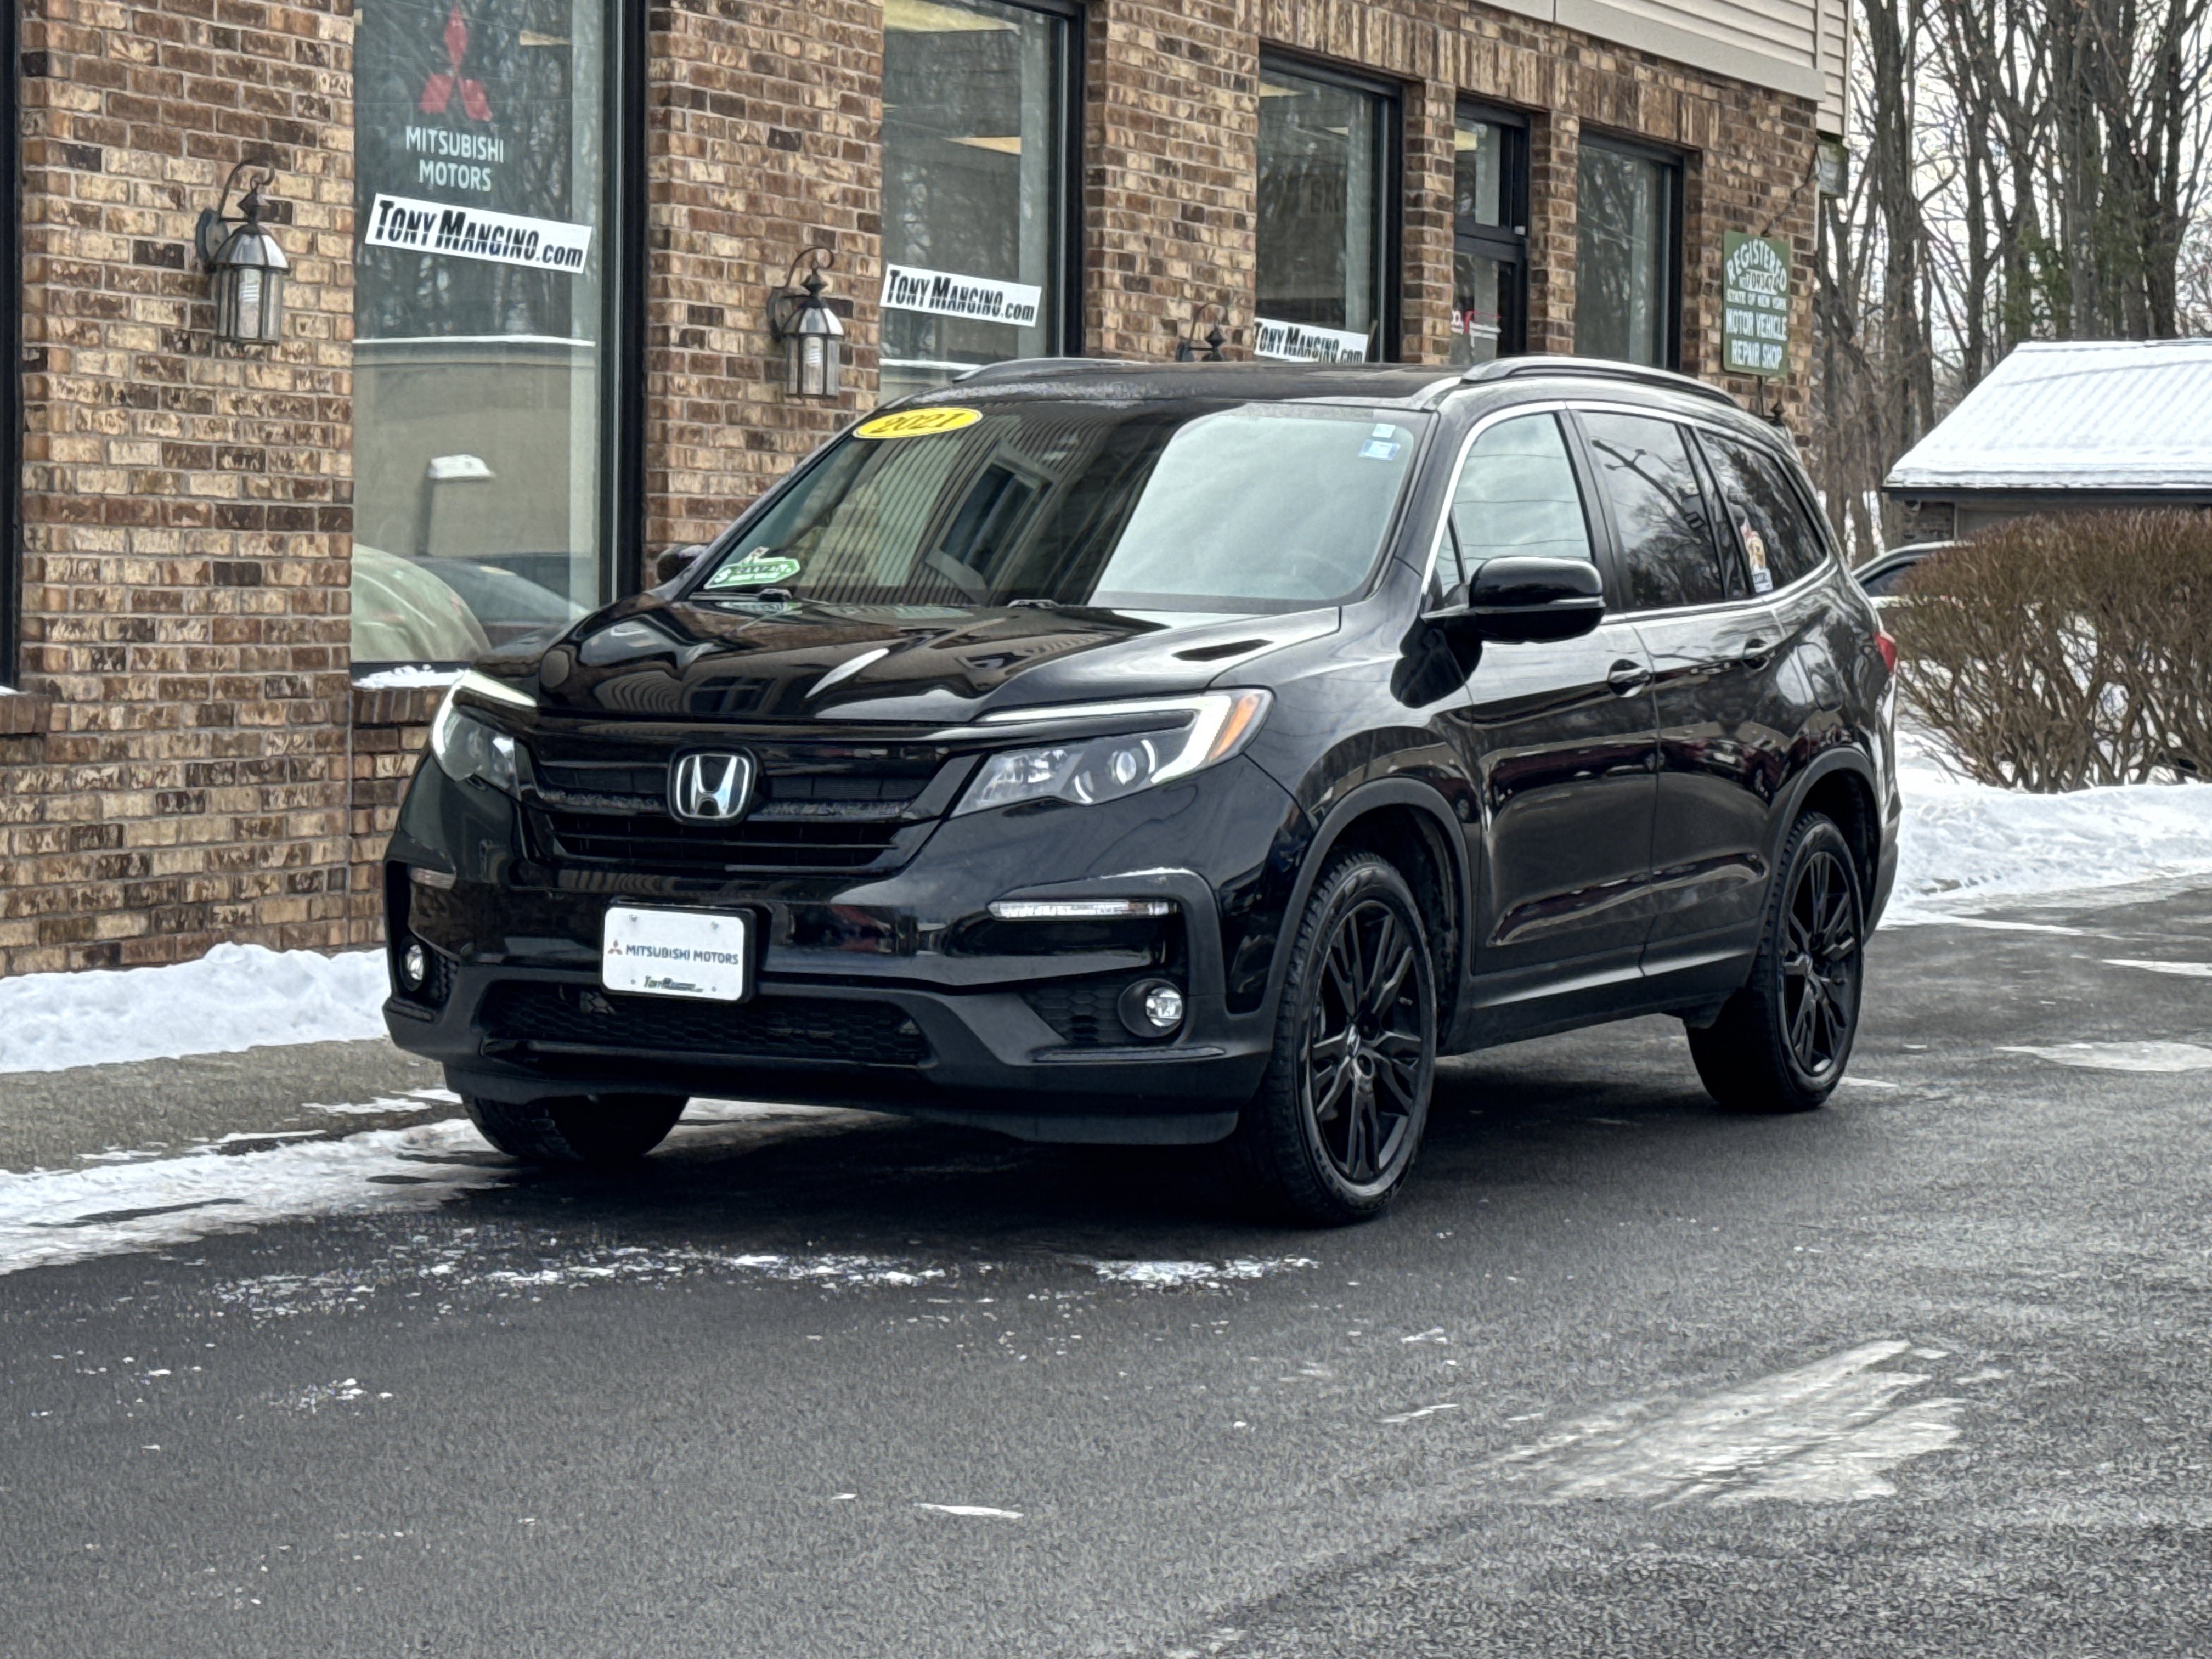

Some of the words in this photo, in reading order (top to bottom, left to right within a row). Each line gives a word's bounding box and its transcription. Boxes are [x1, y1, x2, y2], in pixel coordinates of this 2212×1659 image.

[406, 126, 504, 163] MITSUBISHI
[419, 160, 492, 191] MOTORS
[375, 200, 438, 246] TONY
[1726, 239, 1787, 292] REGISTERED
[887, 269, 930, 307] TONY
[1725, 308, 1754, 337] MOTOR
[1756, 311, 1788, 341] VEHICLE
[1731, 339, 1759, 368] REPAIR
[1762, 343, 1782, 370] SHOP
[869, 413, 966, 433] 2021
[625, 944, 690, 961] MITSUBISHI
[693, 950, 738, 965] MOTORS
